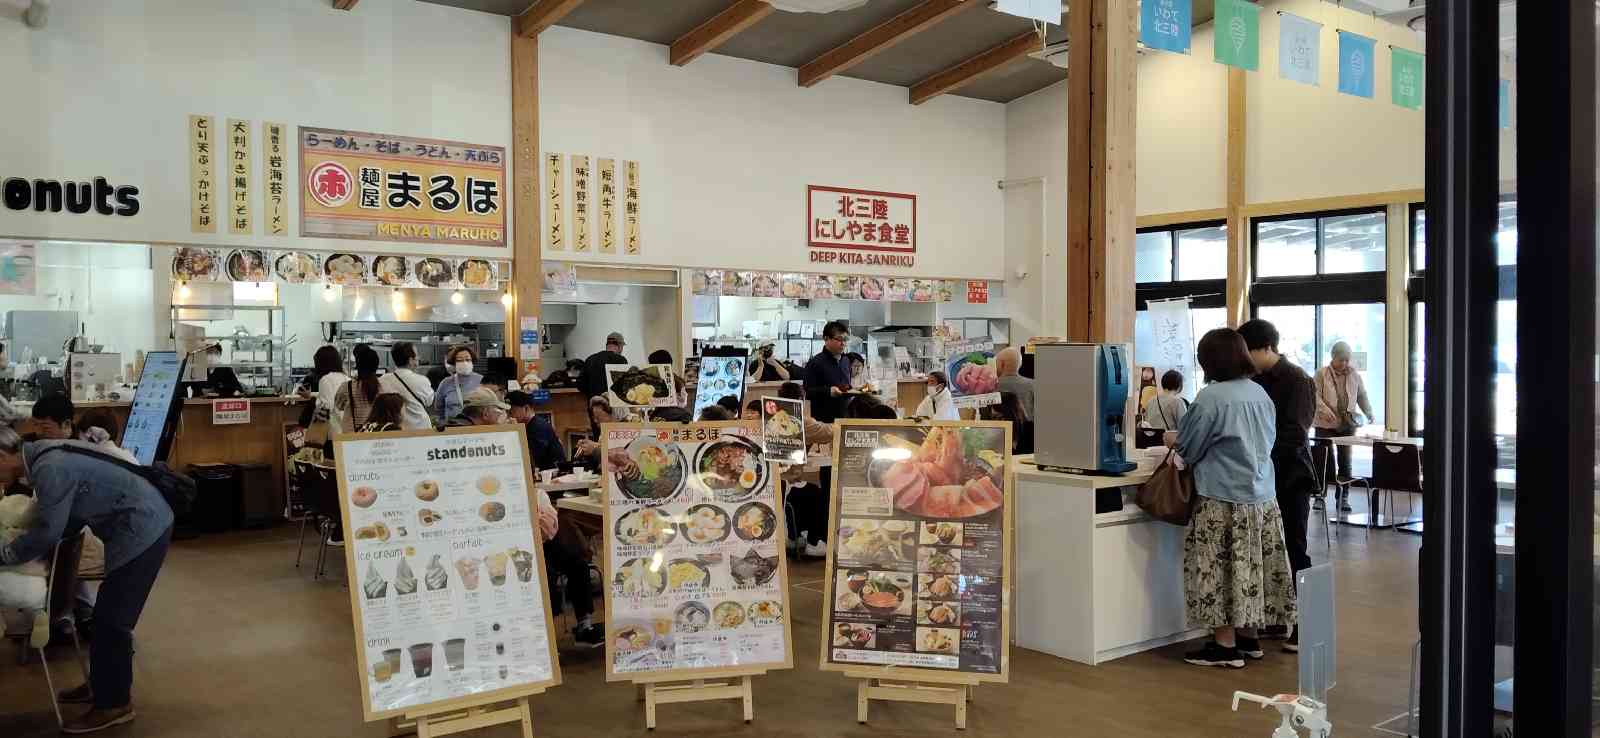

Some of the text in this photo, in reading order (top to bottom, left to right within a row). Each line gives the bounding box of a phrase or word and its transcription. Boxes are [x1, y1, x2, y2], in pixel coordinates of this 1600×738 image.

[386, 171, 499, 214] まるほ
[549, 155, 561, 245] チャーシューメン
[837, 195, 888, 220] 北三陸
[377, 223, 501, 241] MENYA MARUHO
[815, 218, 910, 244] にしやま食堂
[810, 250, 915, 267] DEEP KITA-SANRIKU
[681, 428, 720, 441] まるほ
[426, 443, 506, 461] standonuts
